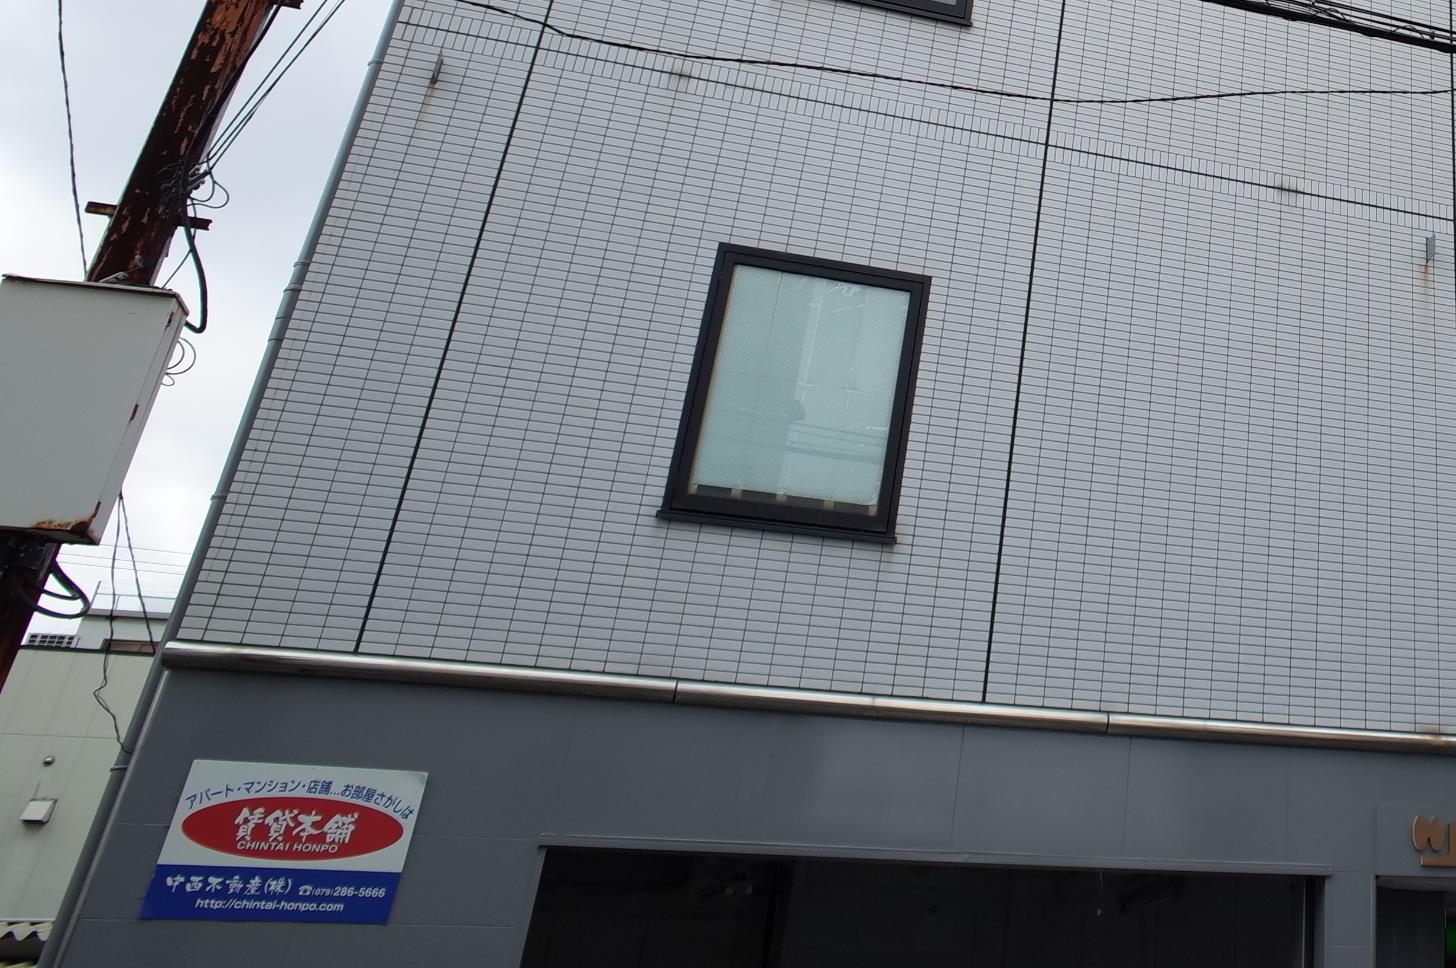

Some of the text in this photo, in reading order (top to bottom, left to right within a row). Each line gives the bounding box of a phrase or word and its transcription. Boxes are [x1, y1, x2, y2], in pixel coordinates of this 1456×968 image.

[234, 807, 359, 844] 賃貸本舗
[236, 841, 338, 853] CHINTAI HONPO
[195, 898, 344, 912] http://chintai-honpo.com
